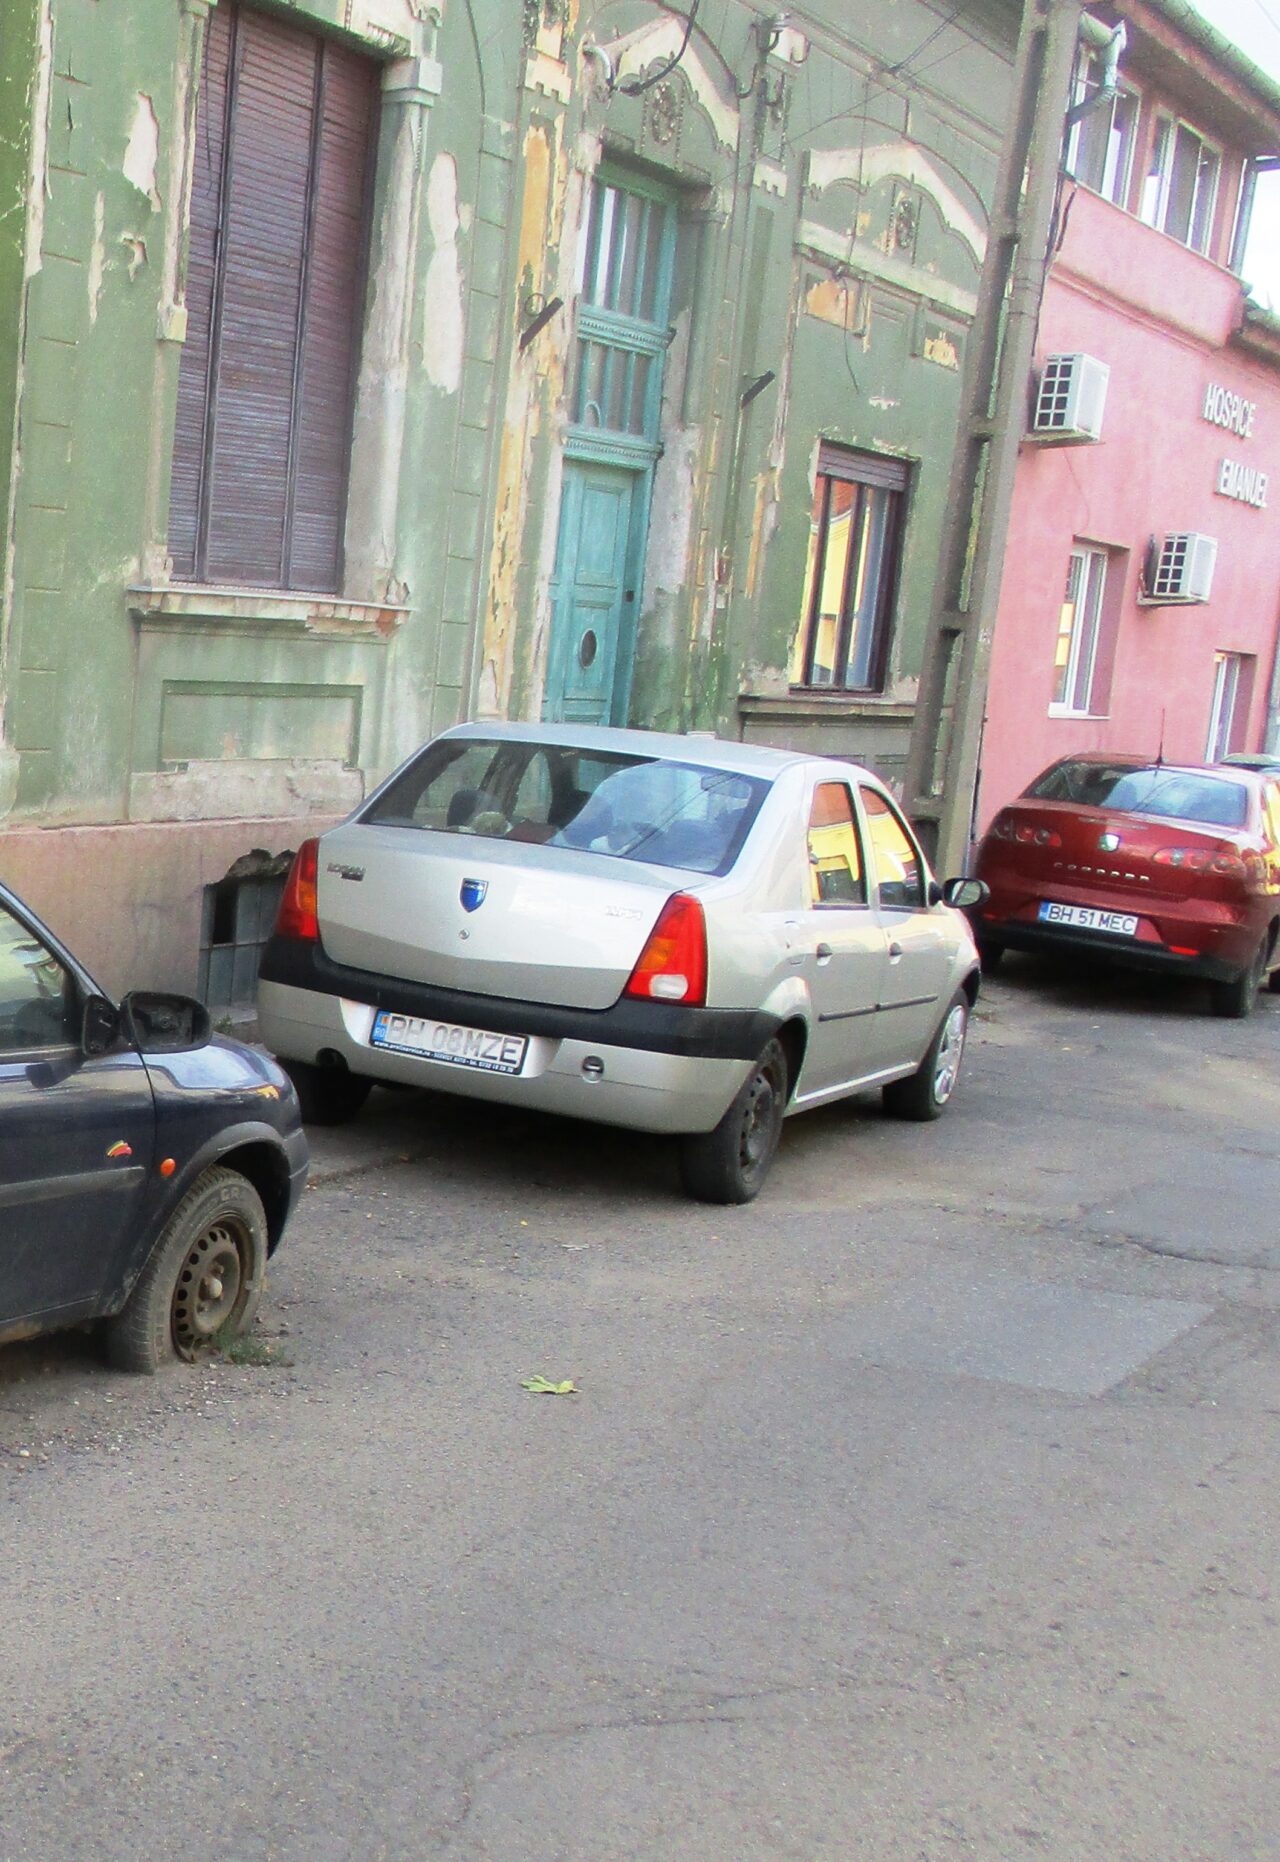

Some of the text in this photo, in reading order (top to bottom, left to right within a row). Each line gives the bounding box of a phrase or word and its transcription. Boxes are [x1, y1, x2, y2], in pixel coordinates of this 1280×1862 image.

[1203, 382, 1256, 438] HOSPICE
[1216, 458, 1267, 508] EMANUEL
[1048, 904, 1136, 932] BH 51 MEC
[387, 1015, 426, 1045] BH
